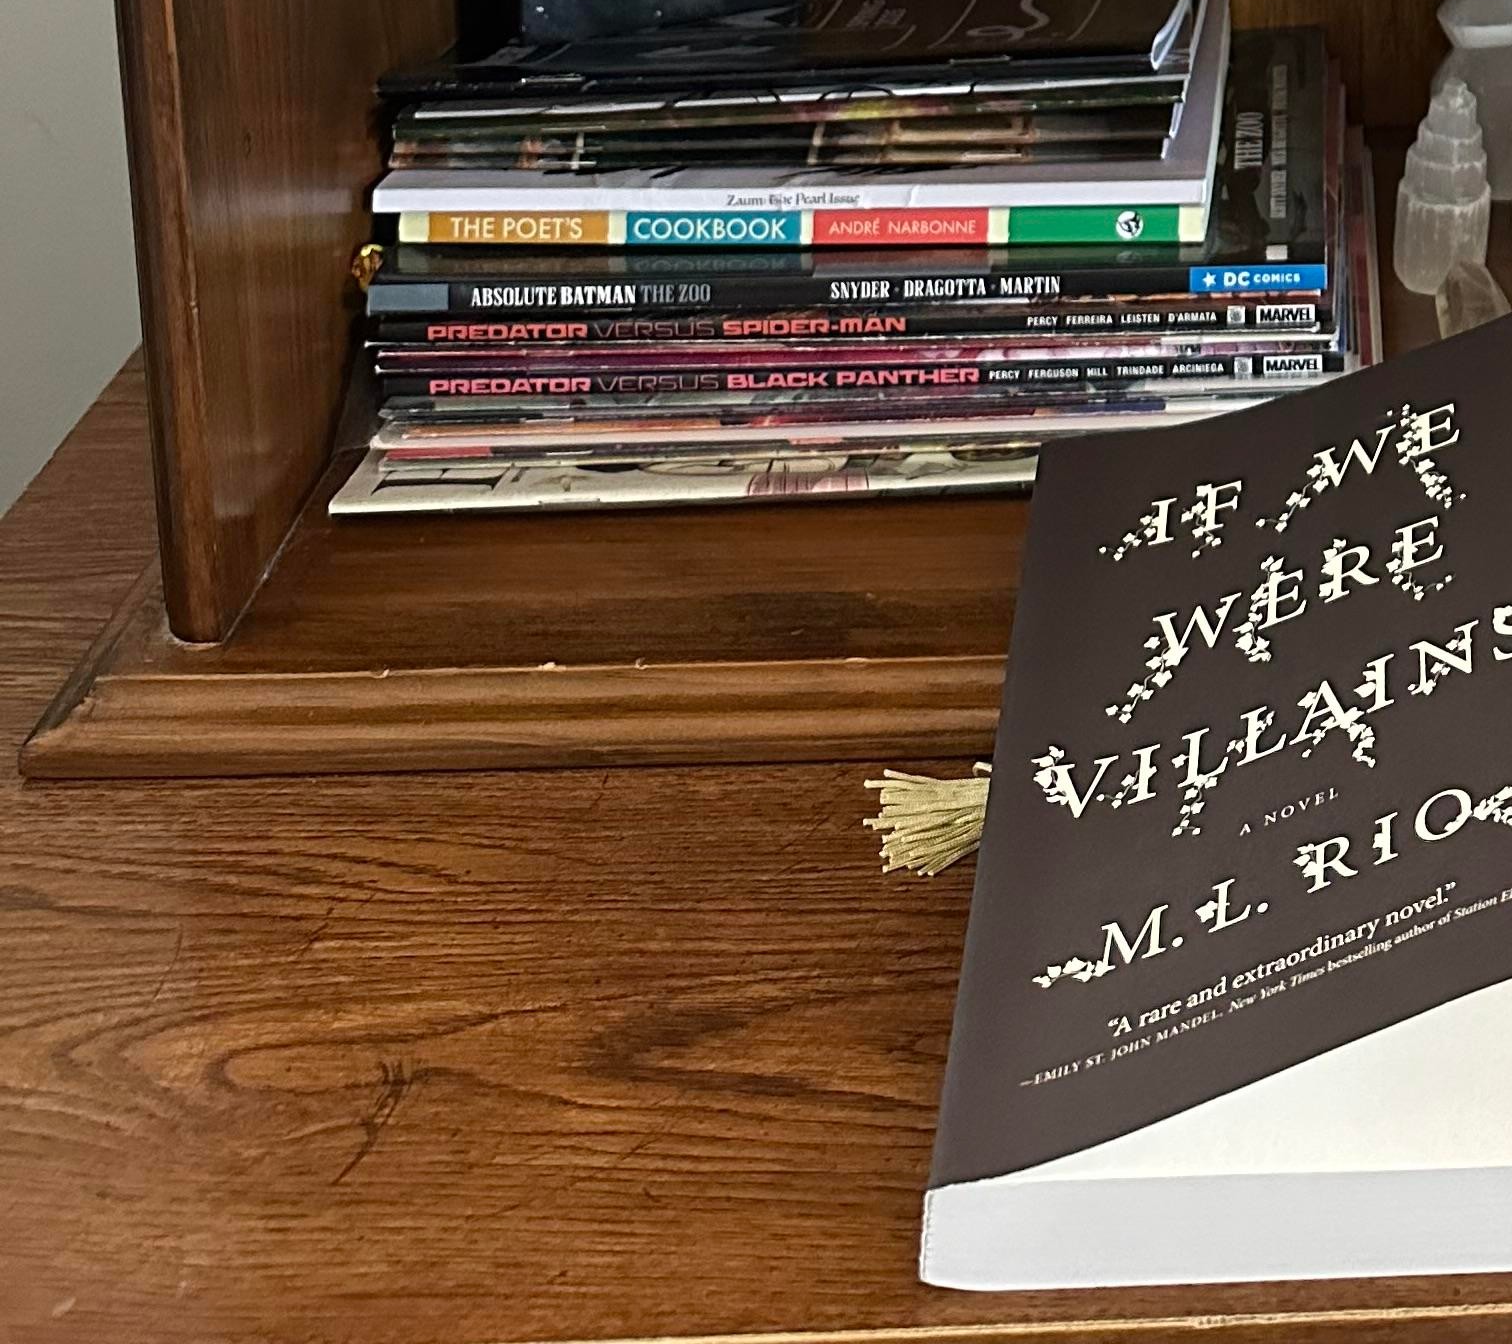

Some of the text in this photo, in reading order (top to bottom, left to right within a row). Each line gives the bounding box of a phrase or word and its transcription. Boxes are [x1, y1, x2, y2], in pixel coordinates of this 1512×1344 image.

[450, 218, 494, 239] THE
[633, 218, 786, 239] COOKBOOK
[828, 218, 879, 236] ANDRÉ
[888, 219, 976, 235] NARBONNE
[471, 271, 1300, 307] ABSOLUTE BATMAN THE ZOO SNYDER DRAGOTTA MARTIN DC COMICS
[427, 324, 588, 341] PREDATOR
[593, 321, 714, 337] VERSUS
[1027, 315, 1057, 326] PERCY
[1066, 313, 1113, 325] FERREIRA
[1120, 313, 1159, 324] LEISTEN
[1259, 307, 1314, 321] MARVEL
[1139, 996, 1181, 1030] rare
[1187, 977, 1228, 1007] and
[1232, 915, 1380, 990] extraordinary
